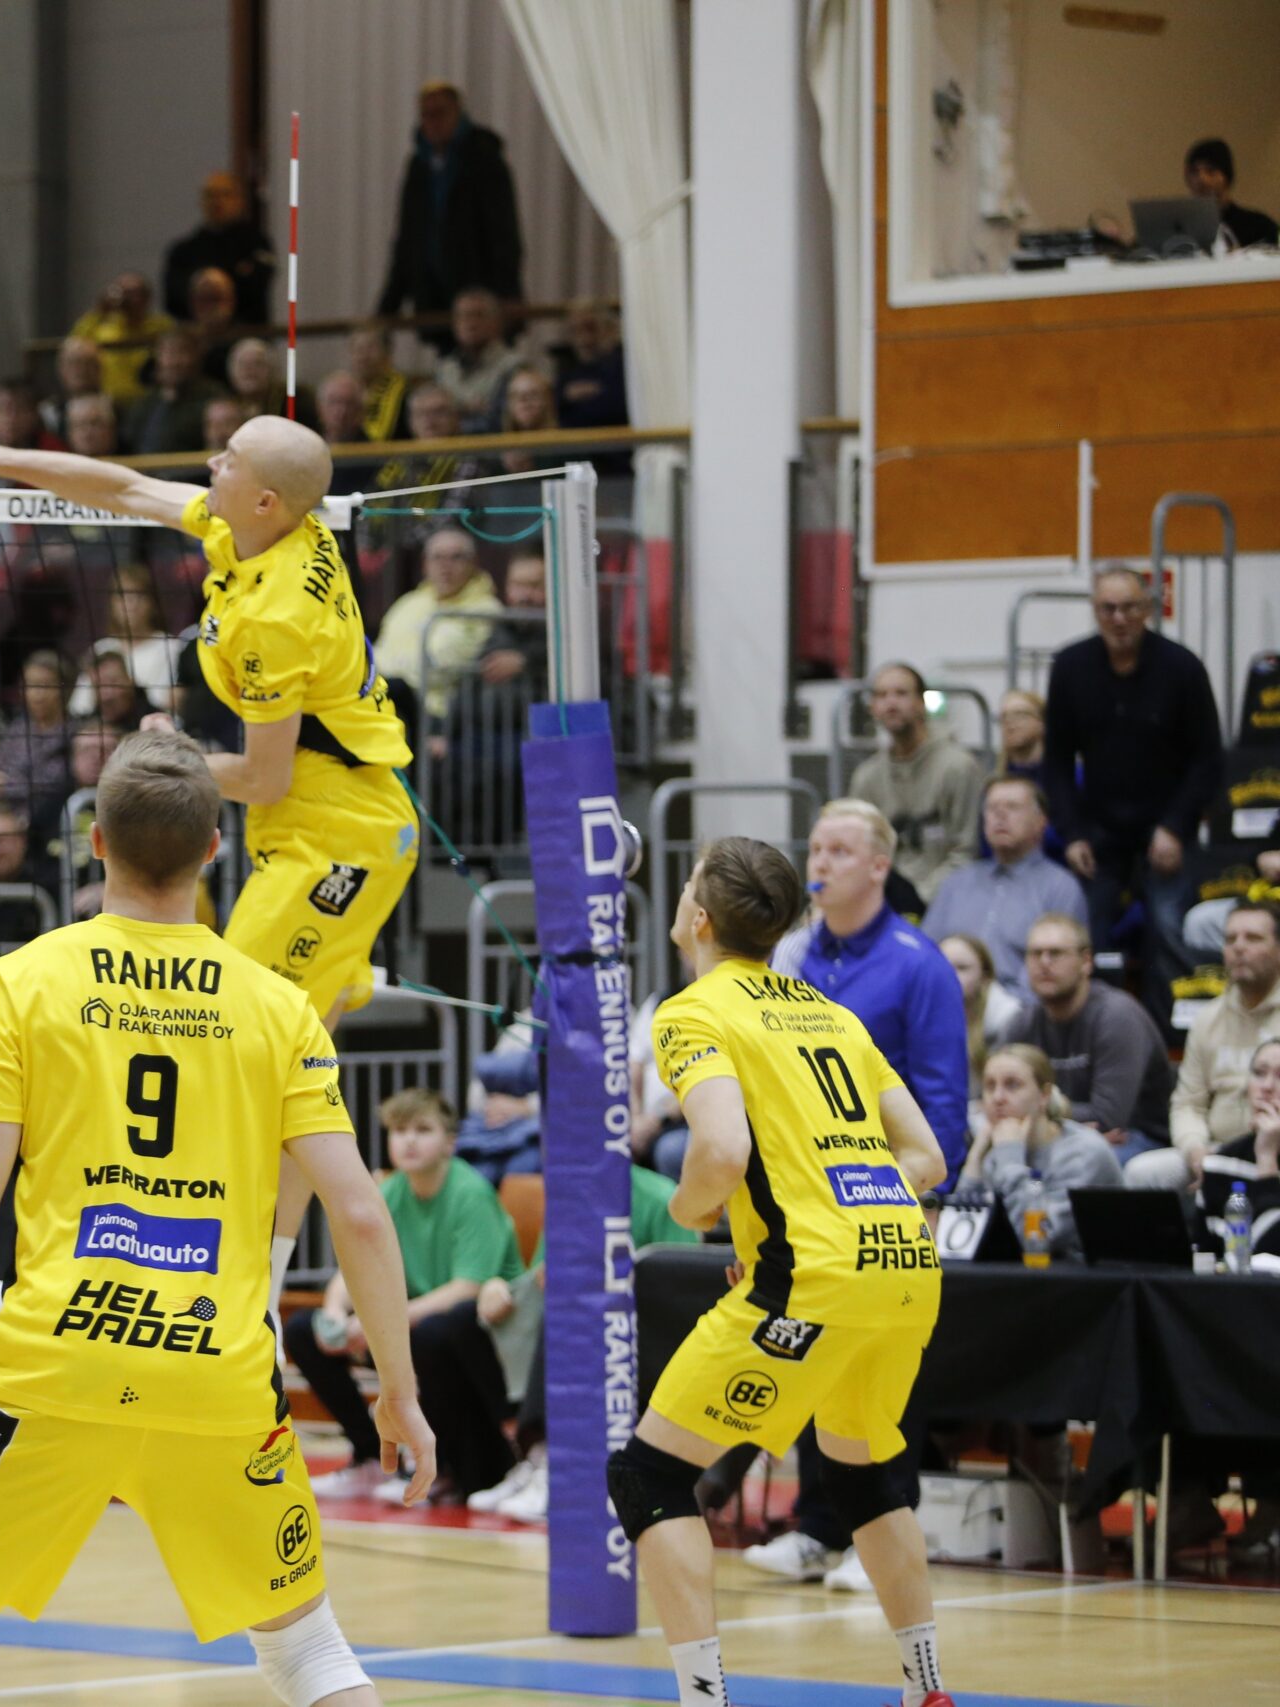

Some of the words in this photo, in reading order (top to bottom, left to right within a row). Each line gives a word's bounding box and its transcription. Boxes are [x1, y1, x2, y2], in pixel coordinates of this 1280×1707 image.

[8, 497, 150, 519] OJARAN
[90, 948, 223, 995] RAHKO
[119, 1002, 220, 1023] OJARANNAN
[586, 893, 628, 1097] RAENNUS
[119, 1018, 208, 1038] RAKENNUS
[213, 1025, 235, 1040] OY
[797, 1045, 868, 1124] 10
[126, 1053, 179, 1159] 9
[604, 1103, 632, 1158] OY
[83, 1165, 226, 1200] WERRATON
[93, 1213, 138, 1231] Loimaan
[858, 1223, 913, 1246] HEL
[86, 1227, 210, 1265] Laatuauto
[856, 1246, 940, 1271] PADEL
[68, 1279, 166, 1319] HEL
[53, 1308, 223, 1356] PADEL
[765, 1325, 805, 1349] STY
[704, 1404, 722, 1421] BE
[730, 1380, 773, 1408] BE
[283, 1511, 308, 1558] BE
[606, 1525, 633, 1582] OY
[270, 1575, 287, 1591] BE
[289, 1554, 318, 1584] GROUP
